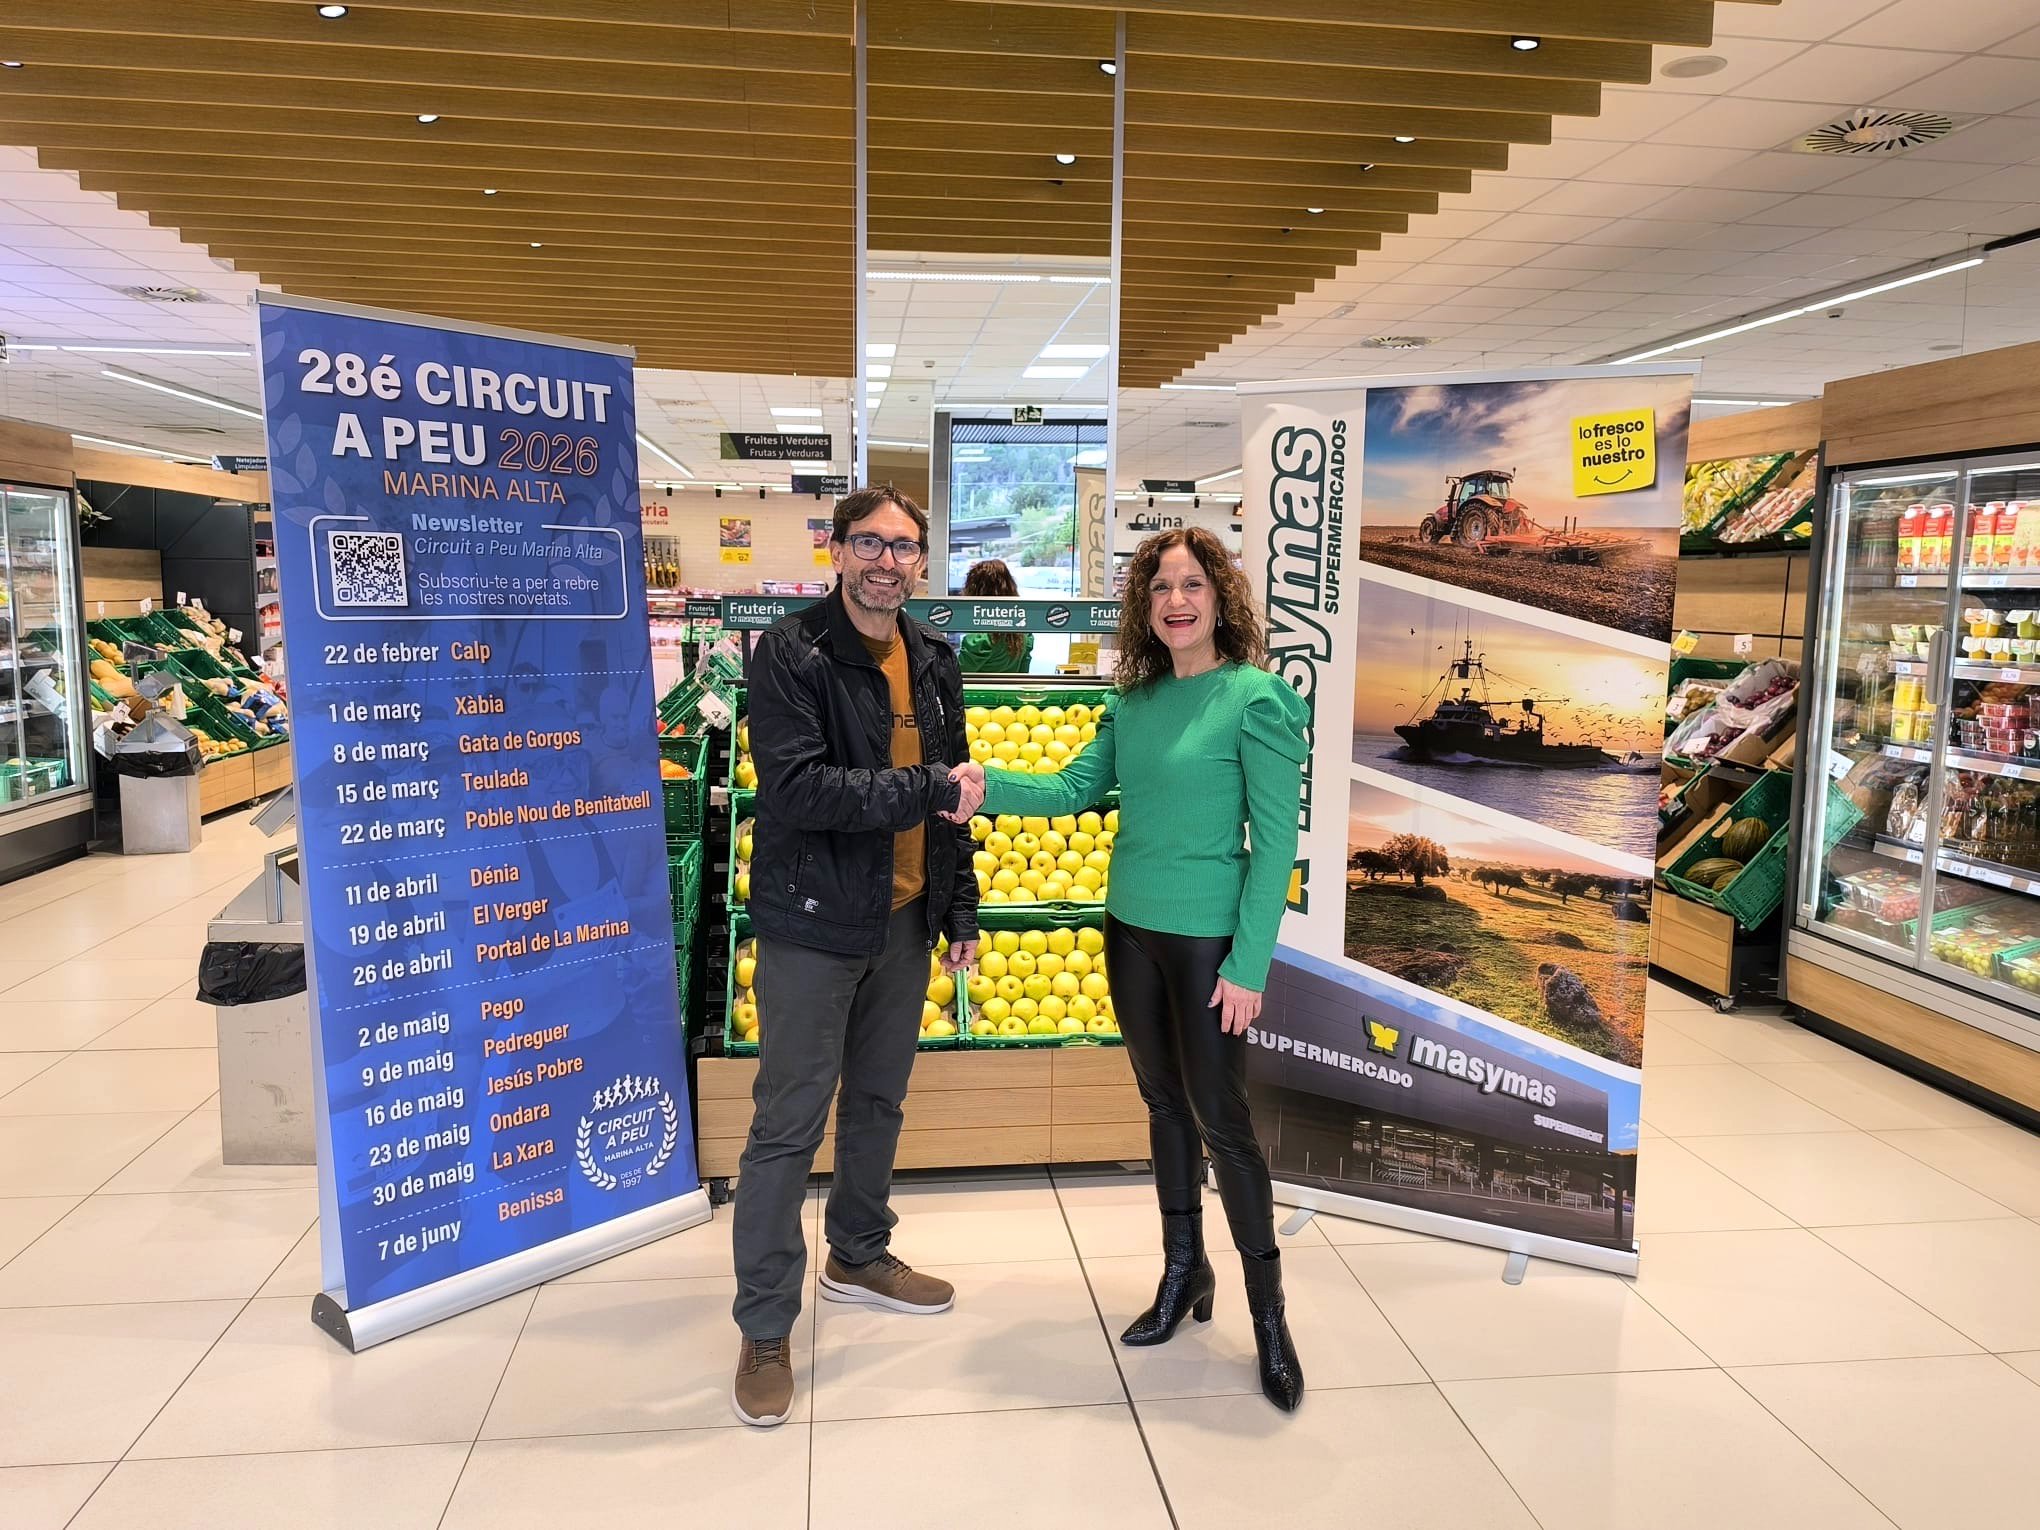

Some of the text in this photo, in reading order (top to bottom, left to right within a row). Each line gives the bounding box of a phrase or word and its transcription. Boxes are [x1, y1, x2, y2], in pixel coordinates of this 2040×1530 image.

[297, 348, 611, 423] 28é CIRCUIT
[744, 436, 829, 446] Fruites i Verdures
[1579, 419, 1644, 440] lo fresco
[1595, 434, 1631, 451] es lo
[332, 412, 598, 476] A PEU 2026
[750, 448, 825, 459] Frutas y Verduras
[1582, 447, 1645, 468] nuestro
[383, 470, 566, 505] MARINA ALTA
[412, 514, 523, 534] Newsletter
[1324, 419, 1347, 615] SUPERMERCADOS
[414, 538, 602, 559] Circuit a Peu Marina Alta
[418, 573, 599, 593] Subscriu-te a per a rebre
[420, 590, 571, 606] les nostres novetats.
[730, 602, 785, 616] Frutería
[973, 605, 1026, 618] Frutería
[325, 641, 491, 664] 22 de febrer Calp
[1742, 642, 1746, 650] 5
[329, 695, 504, 723] 1 de març Xàbia
[334, 729, 581, 763] 8 de març Gata de Gorgos
[337, 768, 528, 803] 15 de març Teulada
[340, 790, 650, 844] 22 de març Poble Nou de Benitatxell
[346, 864, 519, 905] 11 de abril Dénia
[350, 897, 548, 945] 19 de abril El Verger
[353, 919, 629, 986] 26 de abril Portal de La Marina
[358, 997, 524, 1047] 2 de maig Pego
[362, 1022, 569, 1087] 9 de maig Pedreguer
[1247, 1026, 1413, 1088] SUPERMERCADO
[1412, 1036, 1557, 1107] masymas
[365, 1056, 583, 1127] 16 de maig Jesús Pobre
[369, 1102, 550, 1167] 23 de maig Ondara
[598, 1107, 656, 1135] CIRCUIT
[605, 1124, 649, 1149] A PEU
[605, 1142, 654, 1162] MARINA ALTA
[373, 1138, 554, 1206] 30 de maig La Xara
[621, 1171, 632, 1179] DES
[622, 1175, 641, 1188] 1997
[378, 1185, 564, 1261] 7 de juny Benissa
